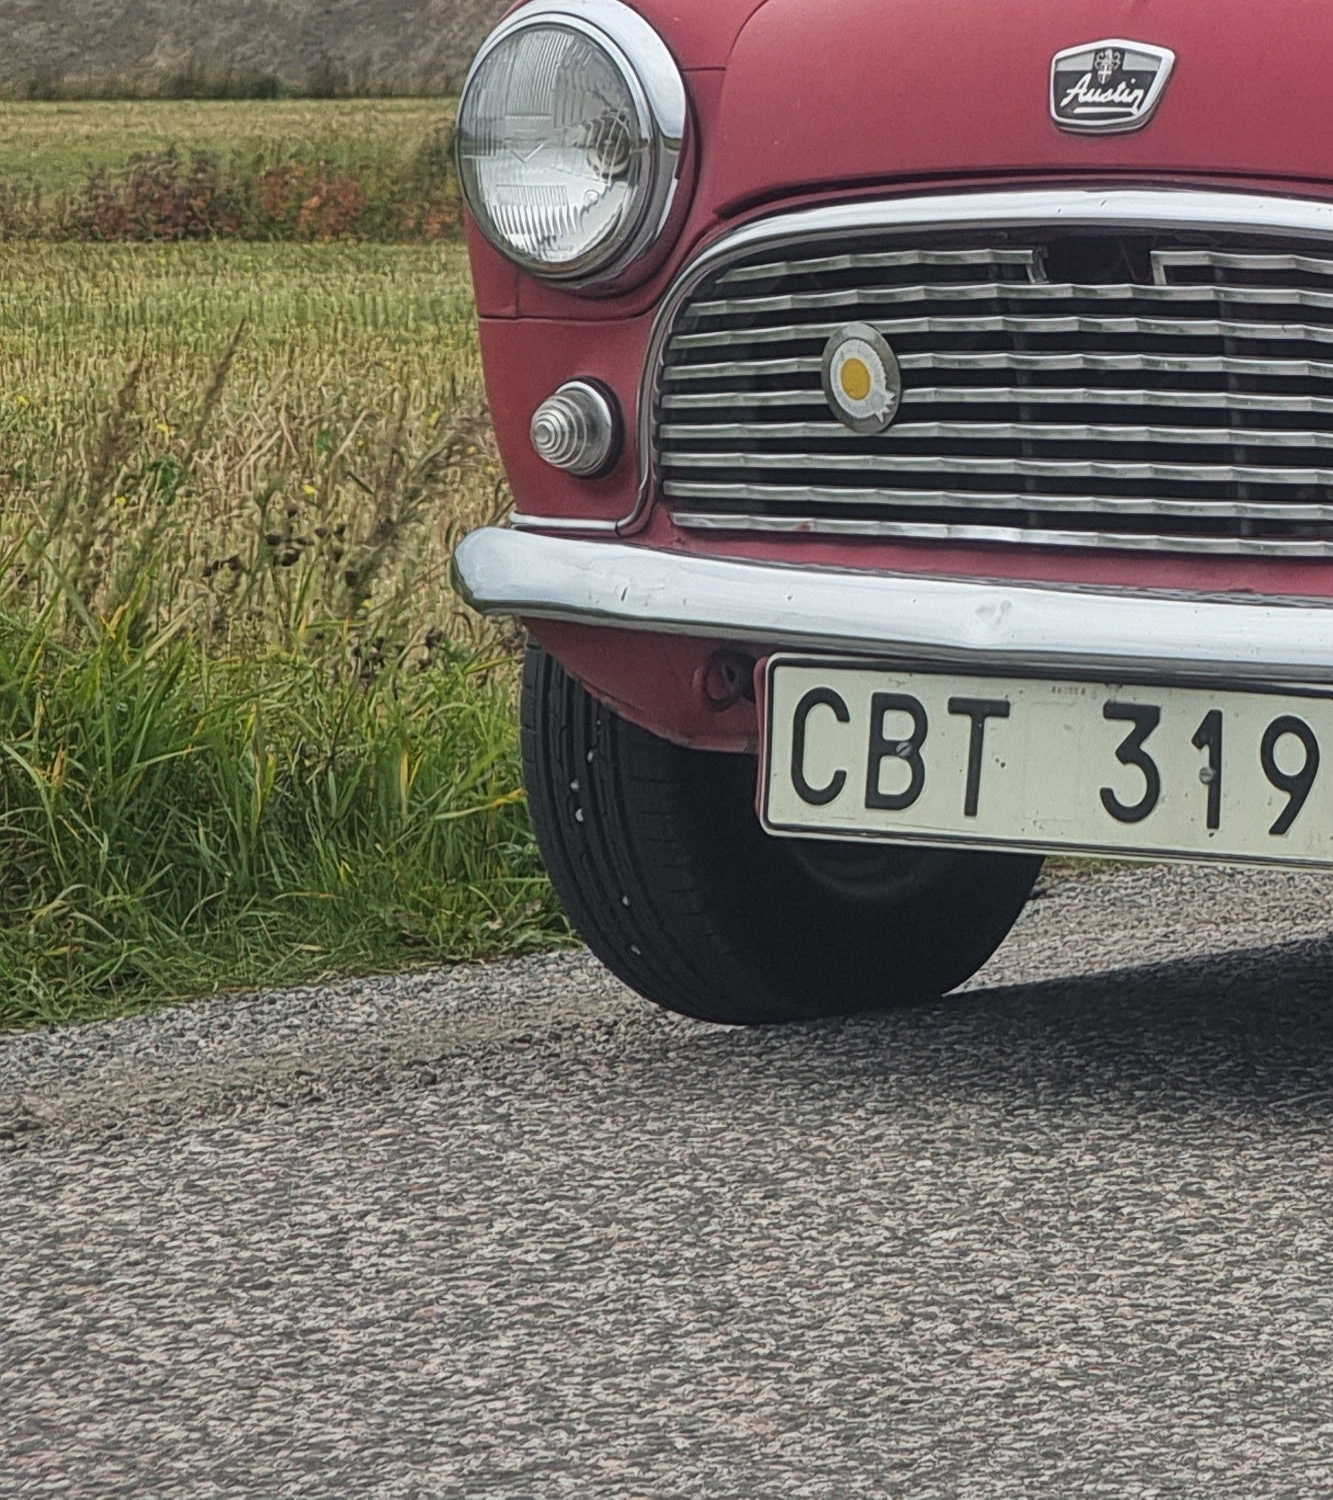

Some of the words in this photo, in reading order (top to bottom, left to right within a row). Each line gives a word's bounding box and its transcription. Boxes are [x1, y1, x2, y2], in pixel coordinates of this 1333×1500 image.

[1060, 72, 1145, 107] Austin
[791, 687, 1010, 817] CBT
[1099, 702, 1320, 836] 319
